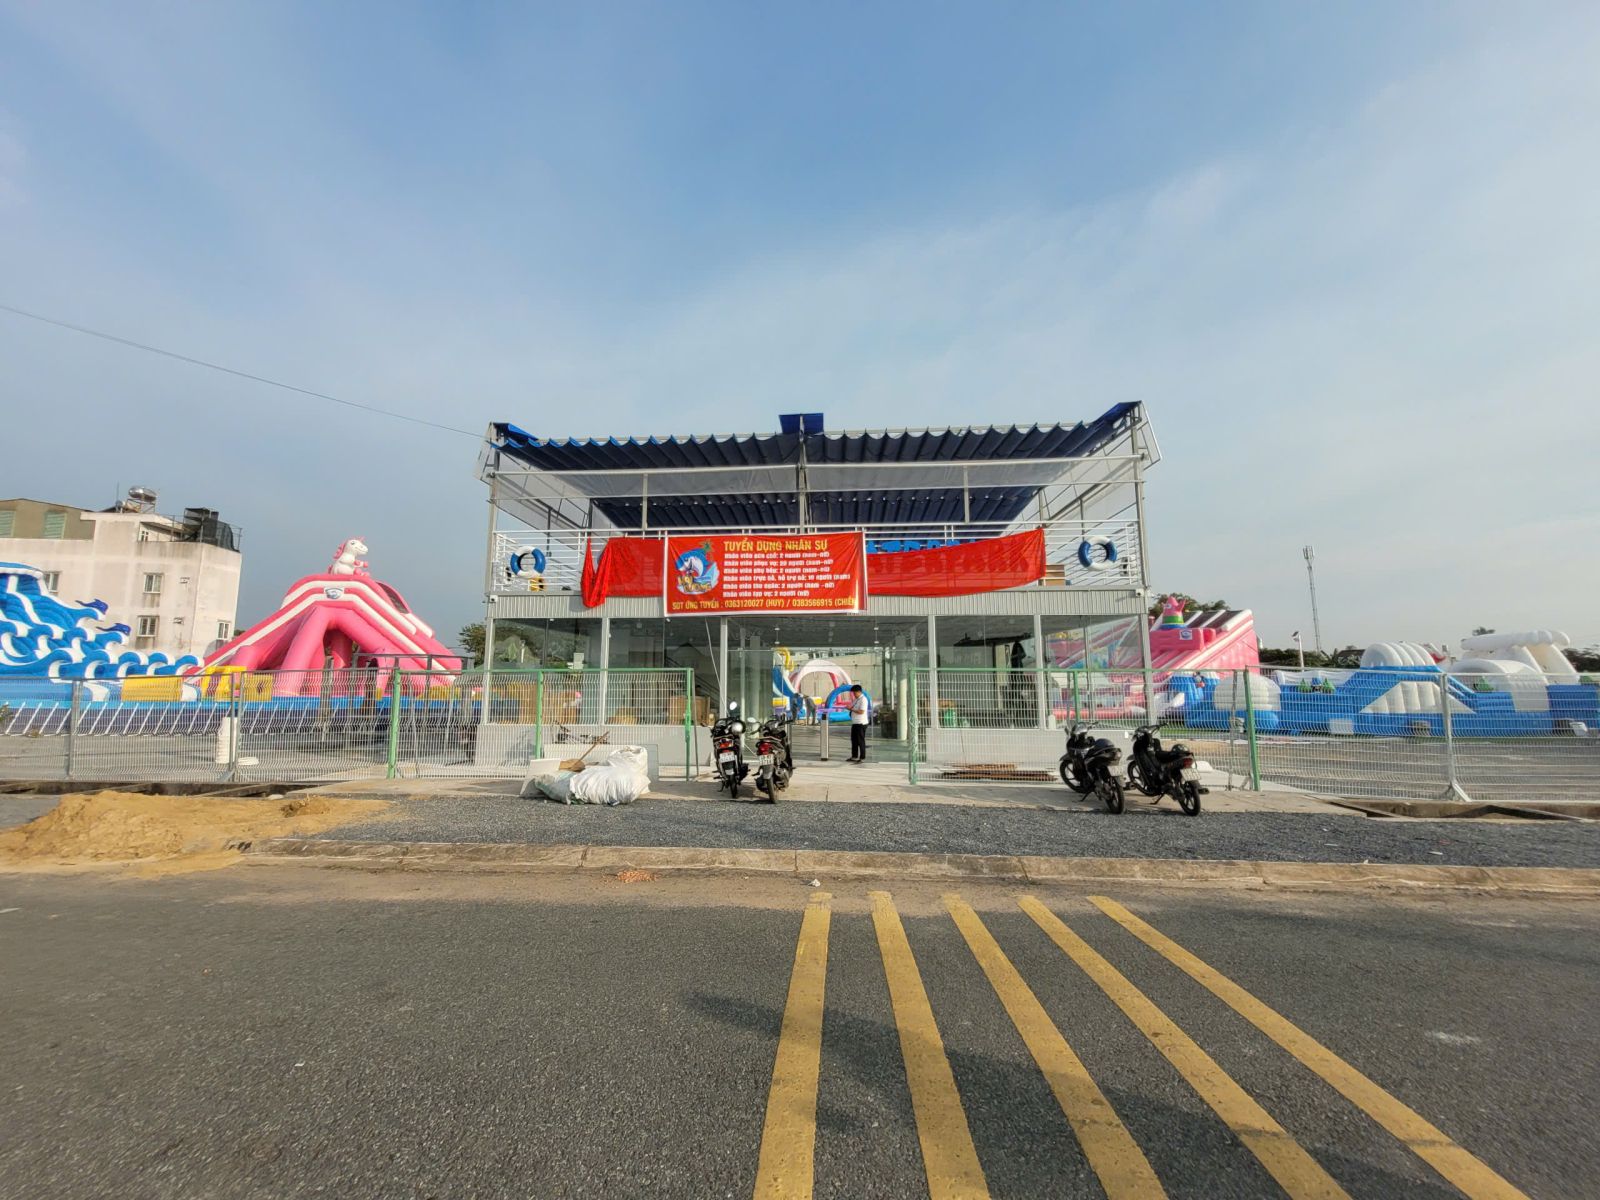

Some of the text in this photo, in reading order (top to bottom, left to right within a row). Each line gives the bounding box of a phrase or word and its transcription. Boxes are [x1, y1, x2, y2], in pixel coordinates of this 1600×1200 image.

[723, 537, 828, 553] TUYỂN DỤNG NHÂN SỰ
